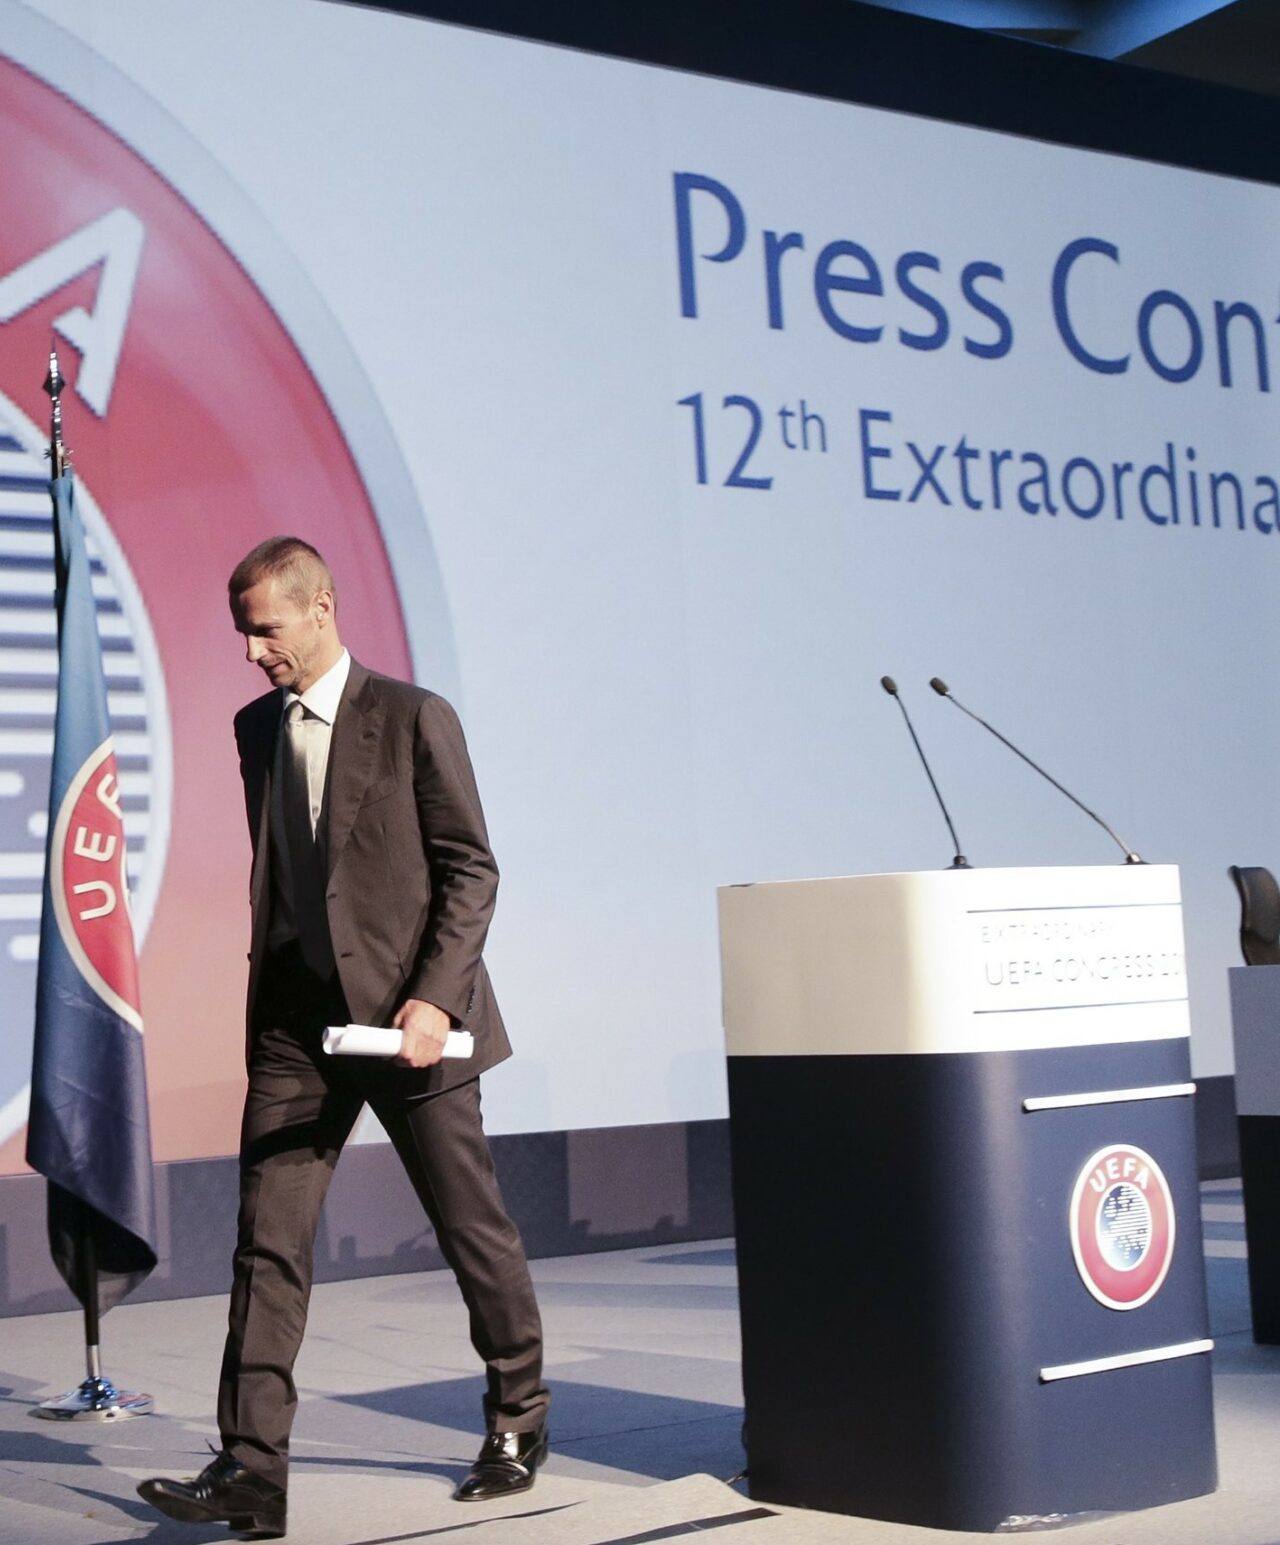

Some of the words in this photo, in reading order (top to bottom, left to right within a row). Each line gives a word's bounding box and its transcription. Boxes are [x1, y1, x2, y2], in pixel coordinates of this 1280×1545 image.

[672, 172, 1013, 359] Press
[1051, 237, 1280, 392] Con
[677, 392, 828, 490] 12th
[858, 408, 1280, 534] Extraordina
[986, 960, 1045, 985] UEFA
[1089, 1157, 1150, 1194] UEFA
